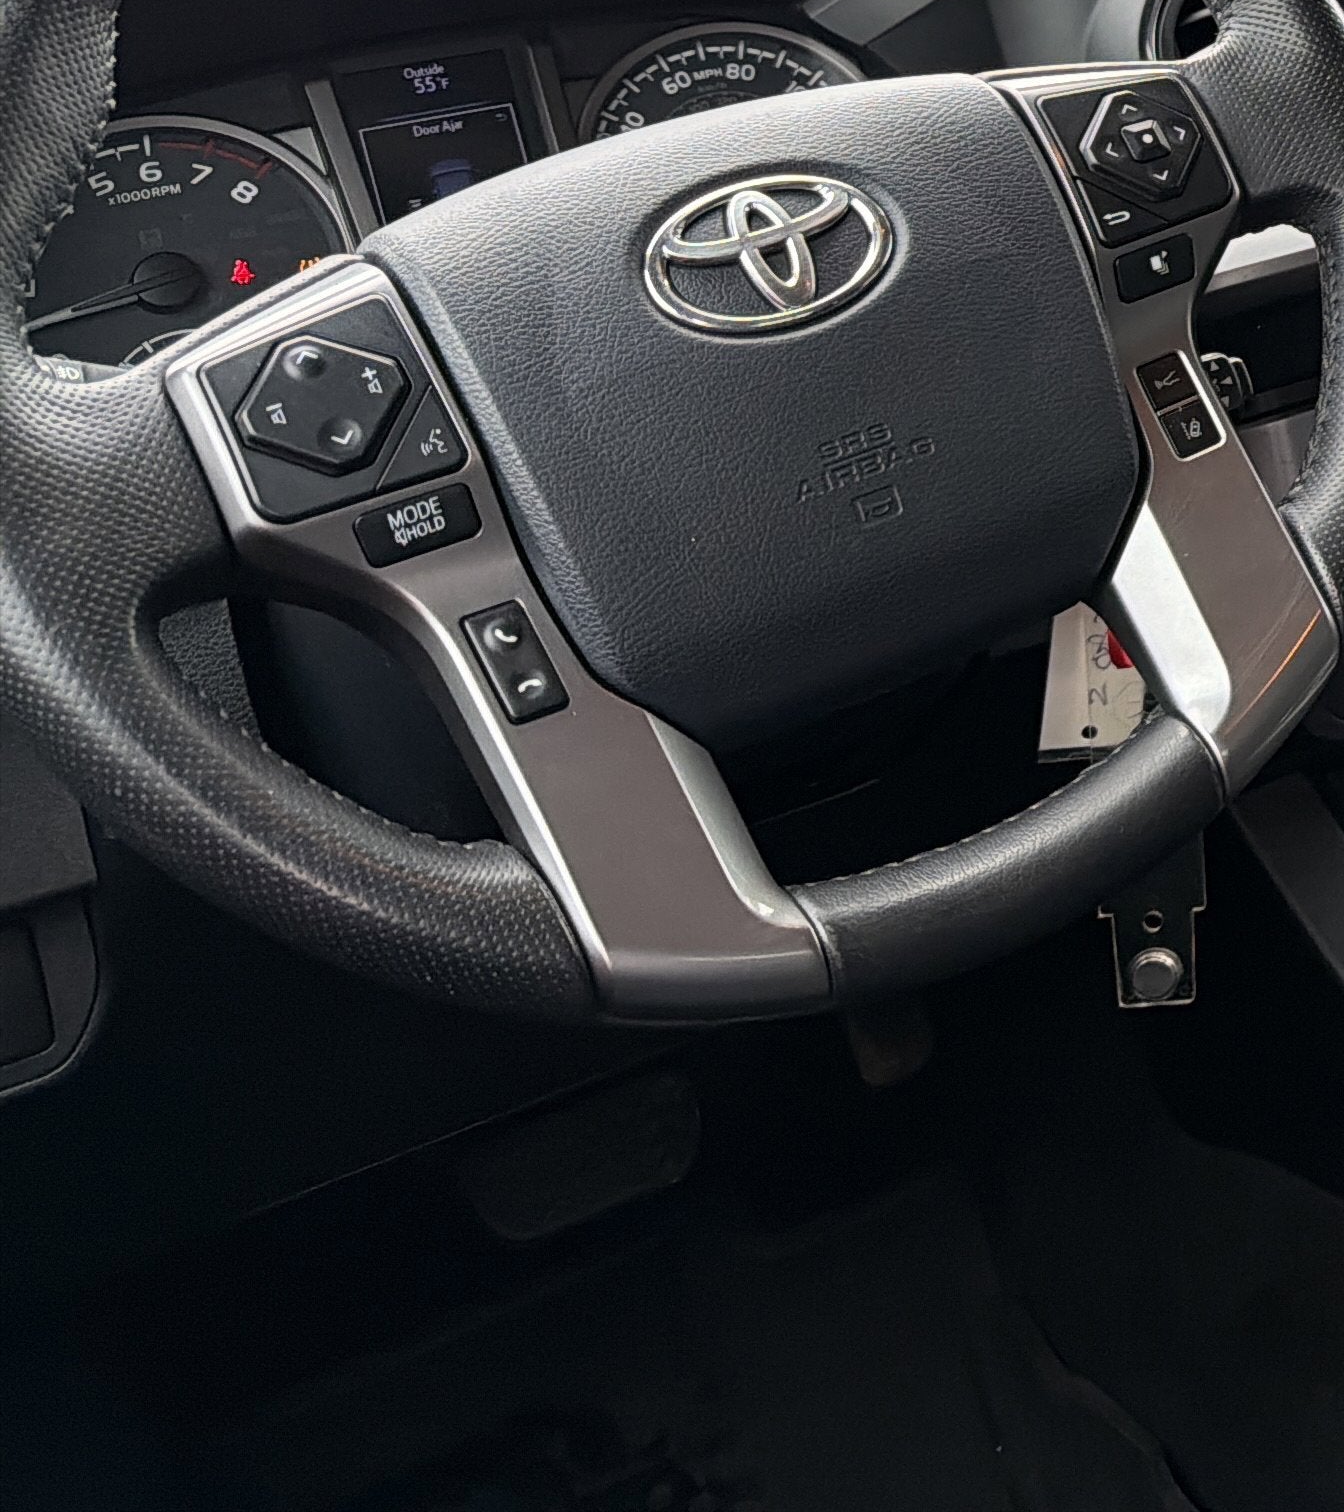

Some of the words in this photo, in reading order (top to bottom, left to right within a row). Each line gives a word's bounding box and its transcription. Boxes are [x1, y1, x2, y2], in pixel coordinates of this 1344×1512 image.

[403, 63, 445, 79] Outside
[661, 70, 693, 96] 60
[693, 67, 723, 82] MPH
[724, 62, 756, 82] 80
[412, 123, 441, 138] Door
[442, 119, 464, 133] Ajar
[87, 171, 115, 197] 5
[139, 160, 163, 183] 6
[190, 163, 214, 185] 7
[229, 180, 259, 205] 8
[817, 422, 893, 460] SRS
[796, 435, 937, 503] AIRBAG
[386, 495, 444, 532] MODE
[405, 514, 447, 541] HOLD
